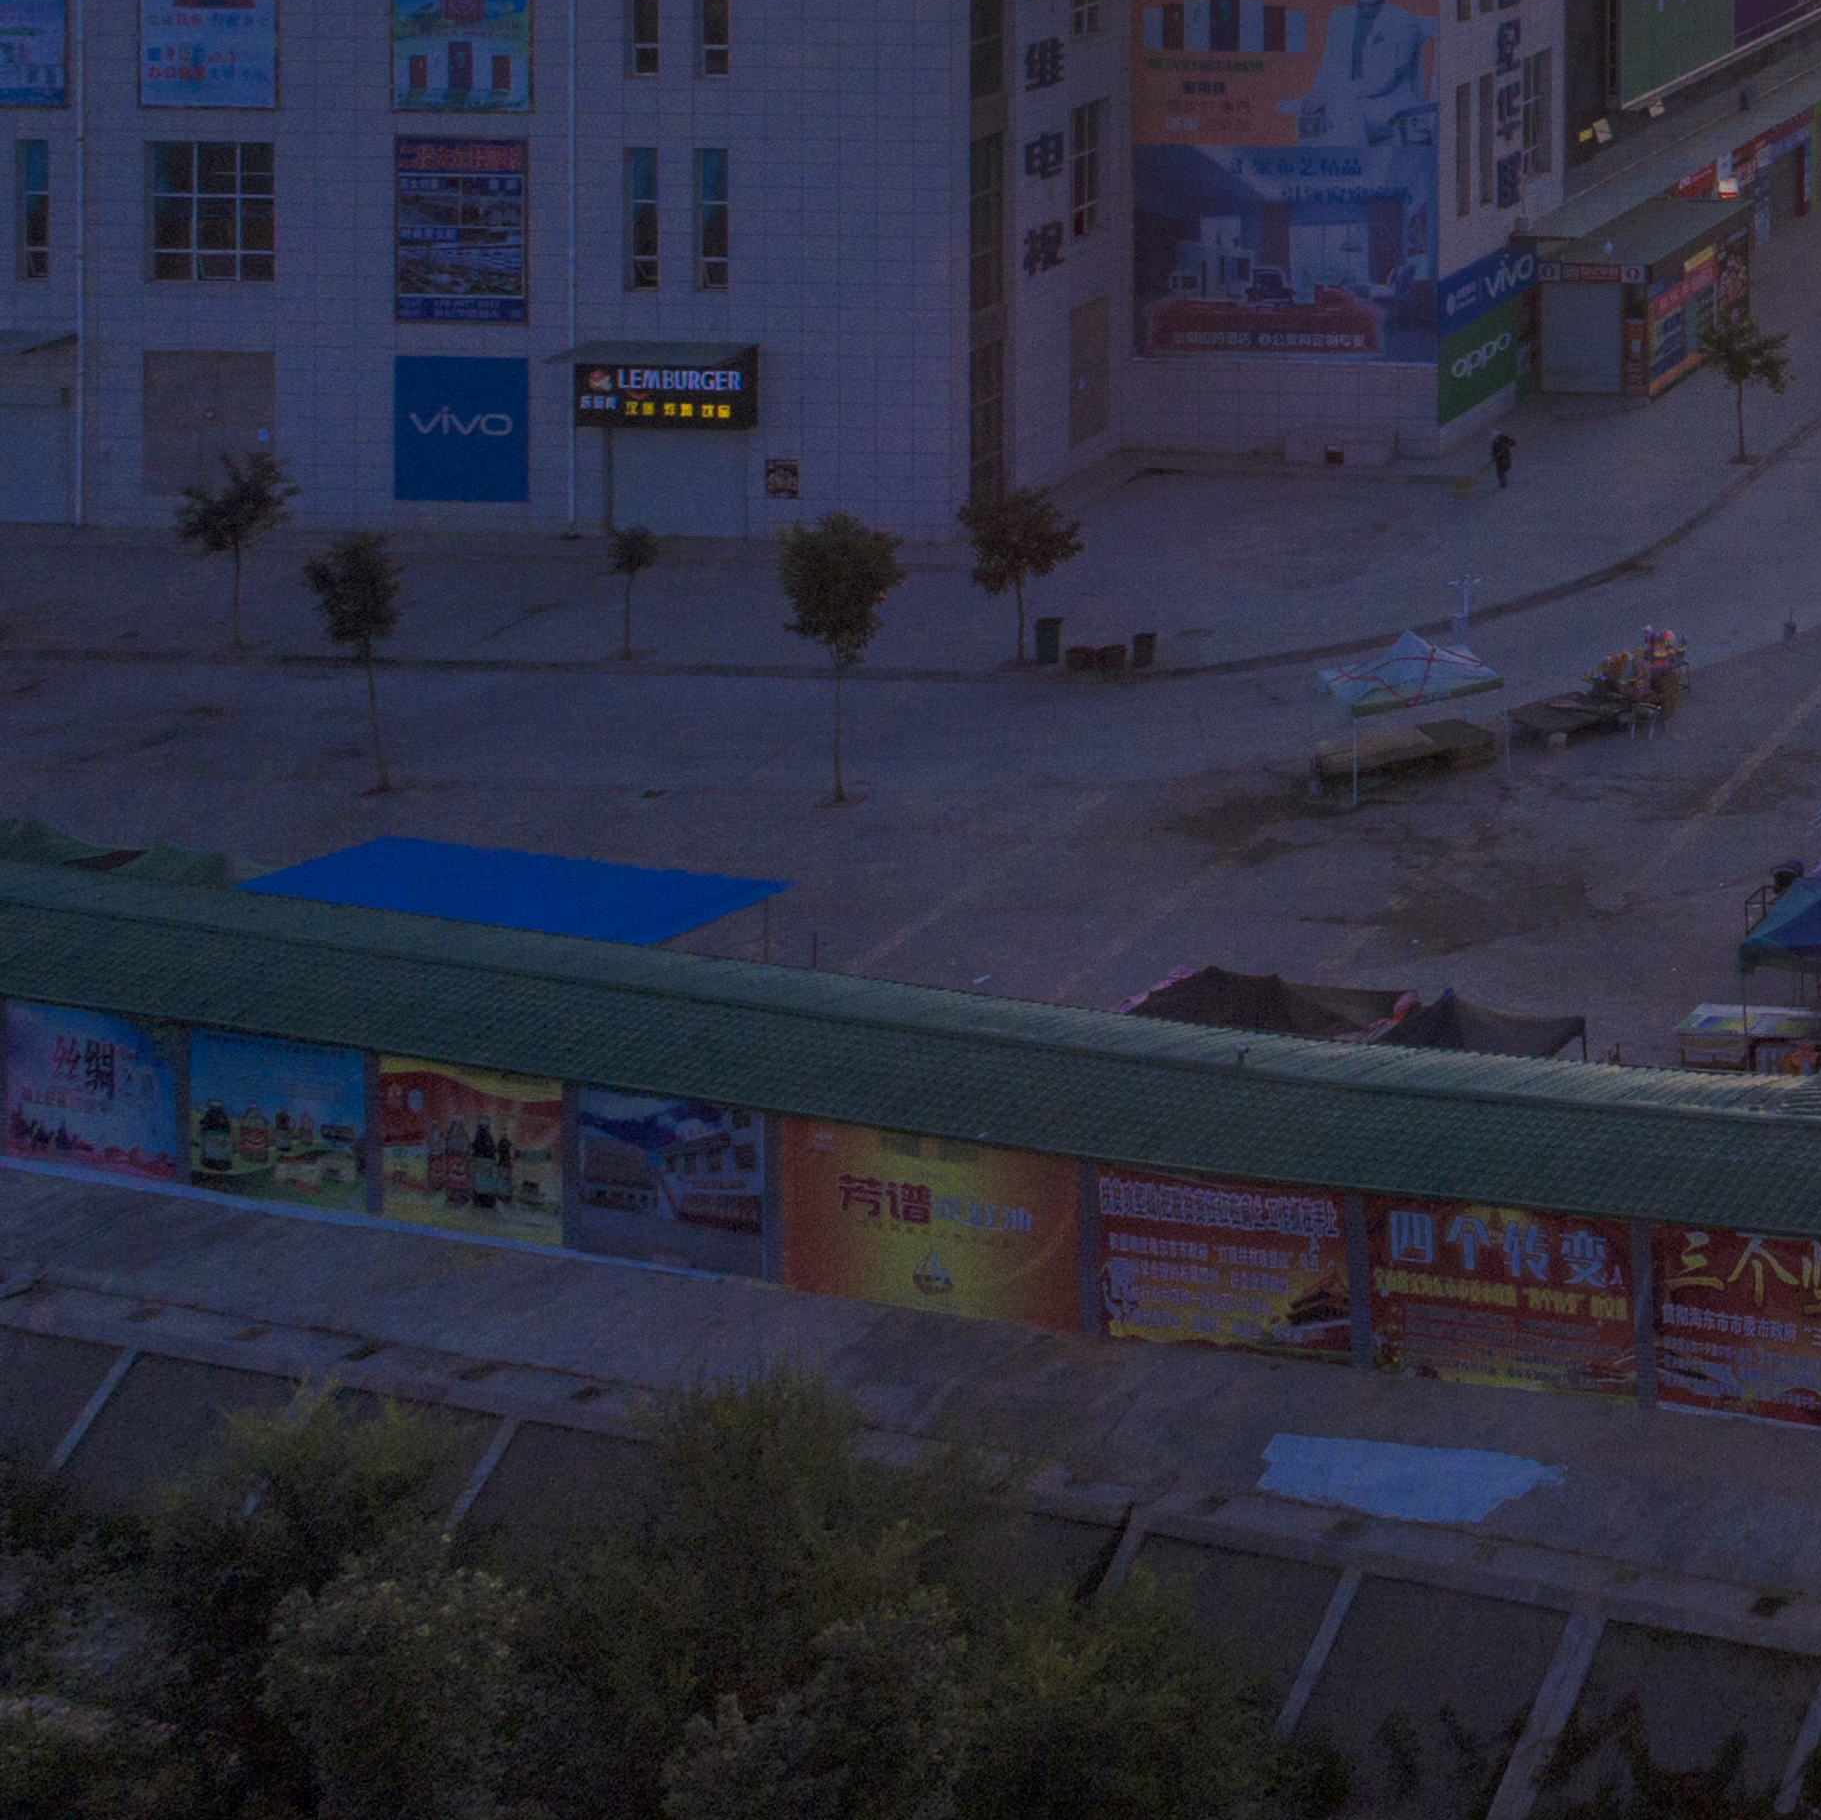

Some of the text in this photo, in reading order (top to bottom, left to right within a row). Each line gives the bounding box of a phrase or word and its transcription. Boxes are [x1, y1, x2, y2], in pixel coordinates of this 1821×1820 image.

[1484, 253, 1535, 298] vivo
[1451, 331, 1512, 379] oppo
[617, 368, 743, 391] LEMBURGER
[408, 405, 514, 436] vivo
[1390, 1209, 1608, 1288] 四个转变
